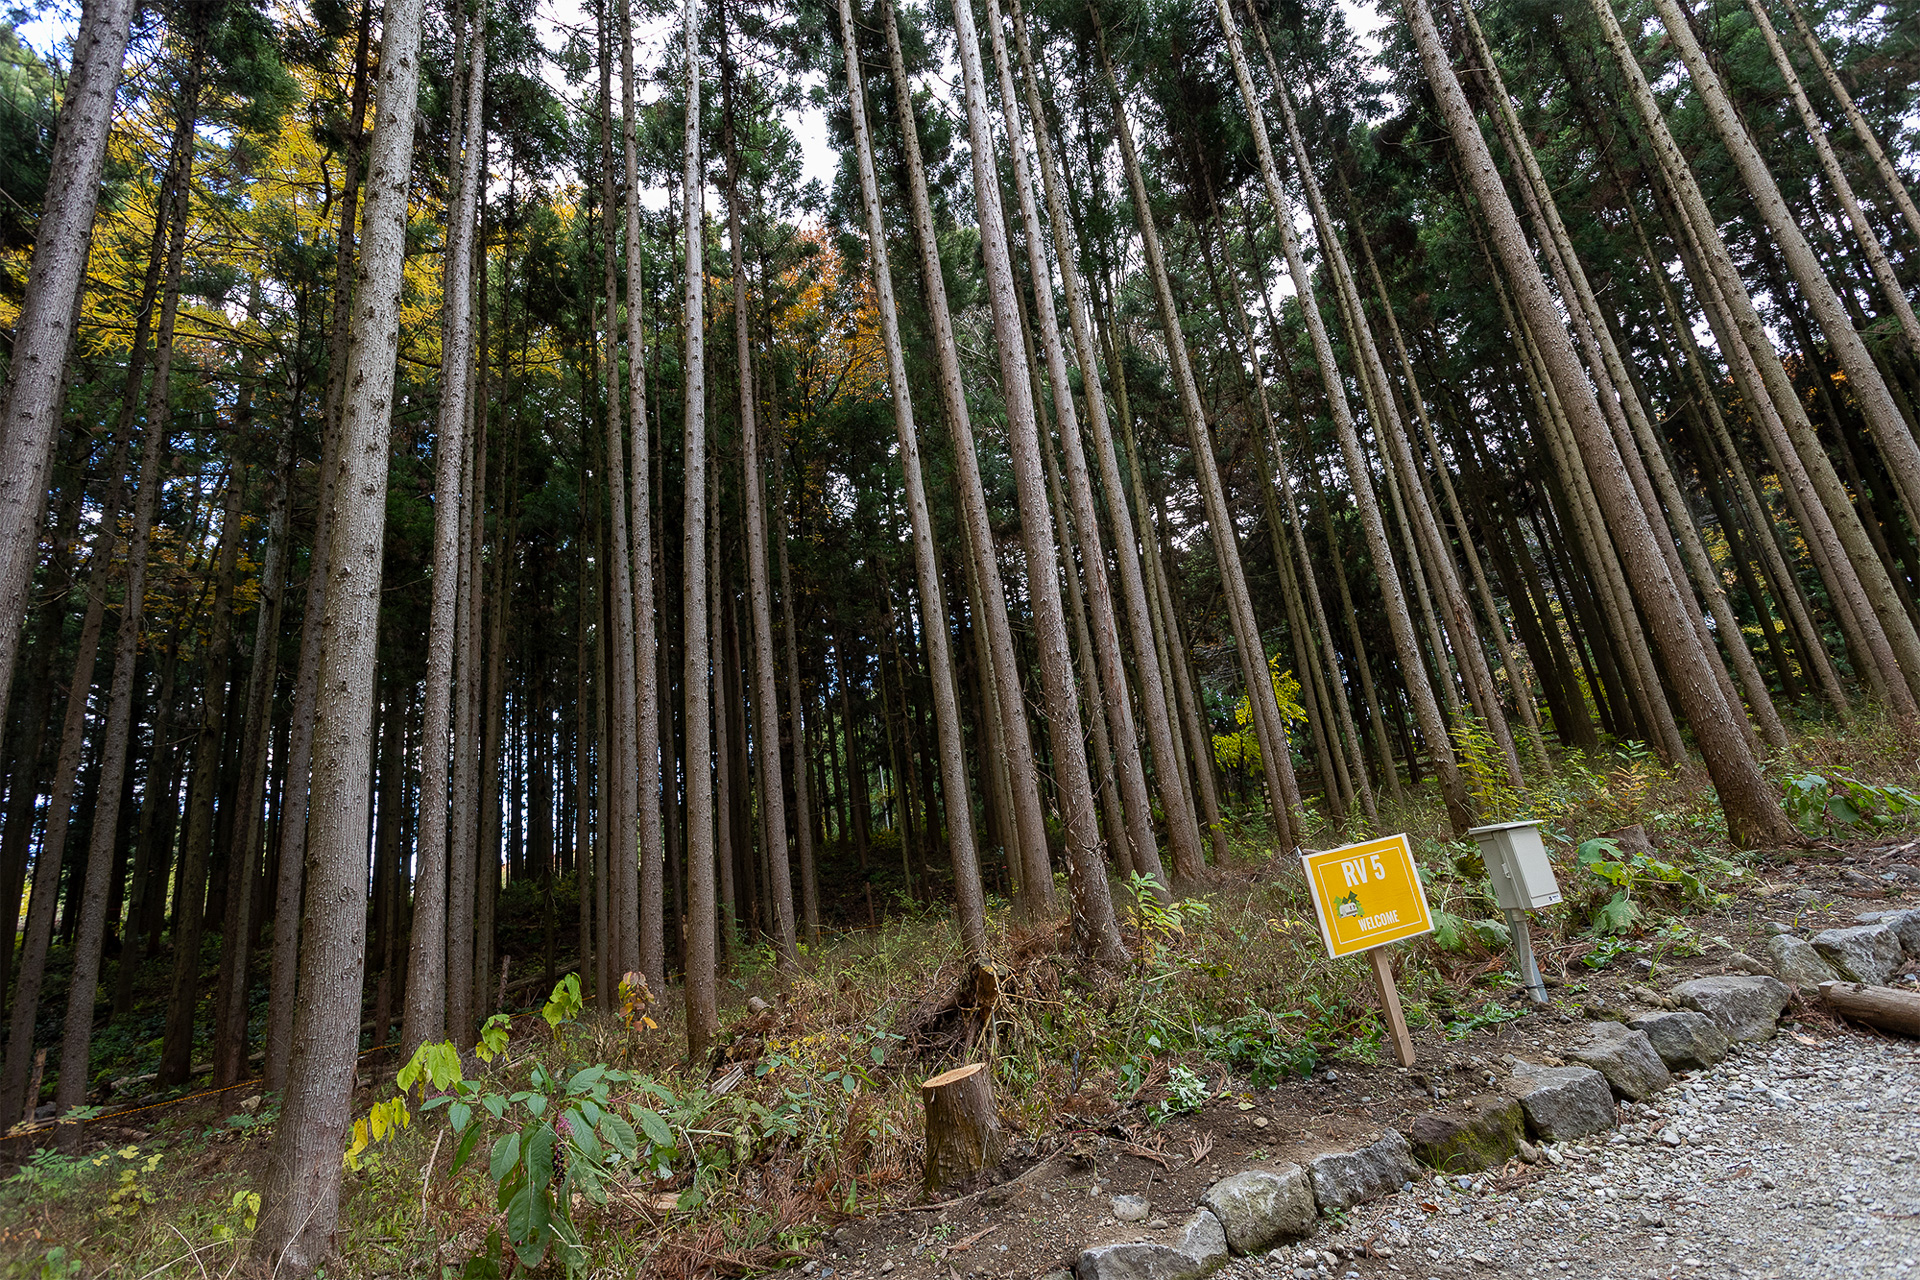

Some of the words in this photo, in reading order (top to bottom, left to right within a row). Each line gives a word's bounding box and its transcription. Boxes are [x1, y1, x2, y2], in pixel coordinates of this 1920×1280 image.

[1341, 858, 1368, 887] RV
[1370, 854, 1386, 880] 5
[1358, 909, 1400, 932] WELCOME
